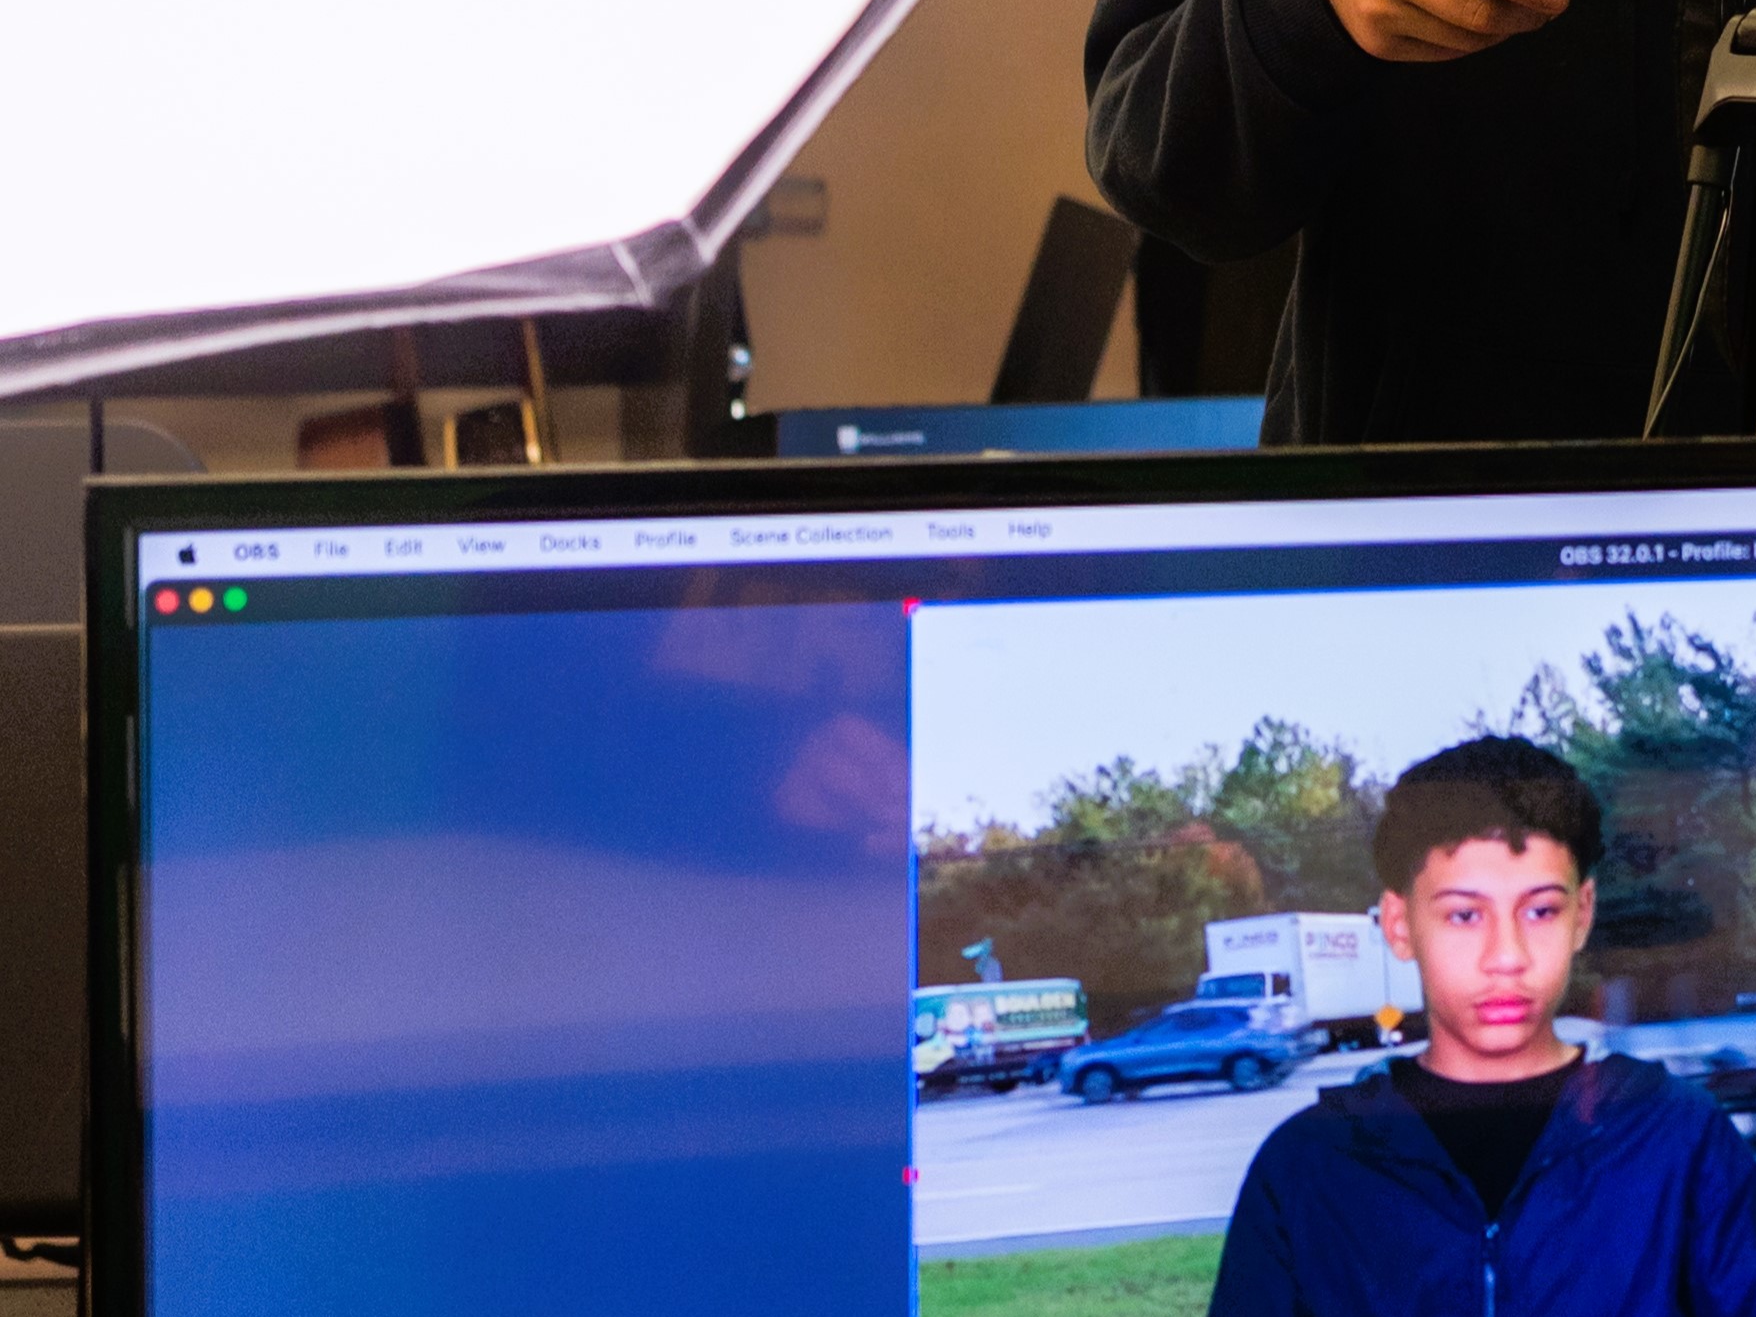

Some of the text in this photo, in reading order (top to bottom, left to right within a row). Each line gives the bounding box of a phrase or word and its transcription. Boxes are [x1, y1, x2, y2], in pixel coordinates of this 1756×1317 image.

[233, 519, 1053, 561] OBS File Edit View Docks Profile Scene Collection Tools Help
[1560, 545, 1601, 565] OBS
[1606, 543, 1665, 564] 32.0.1
[1681, 539, 1749, 562] Profile:
